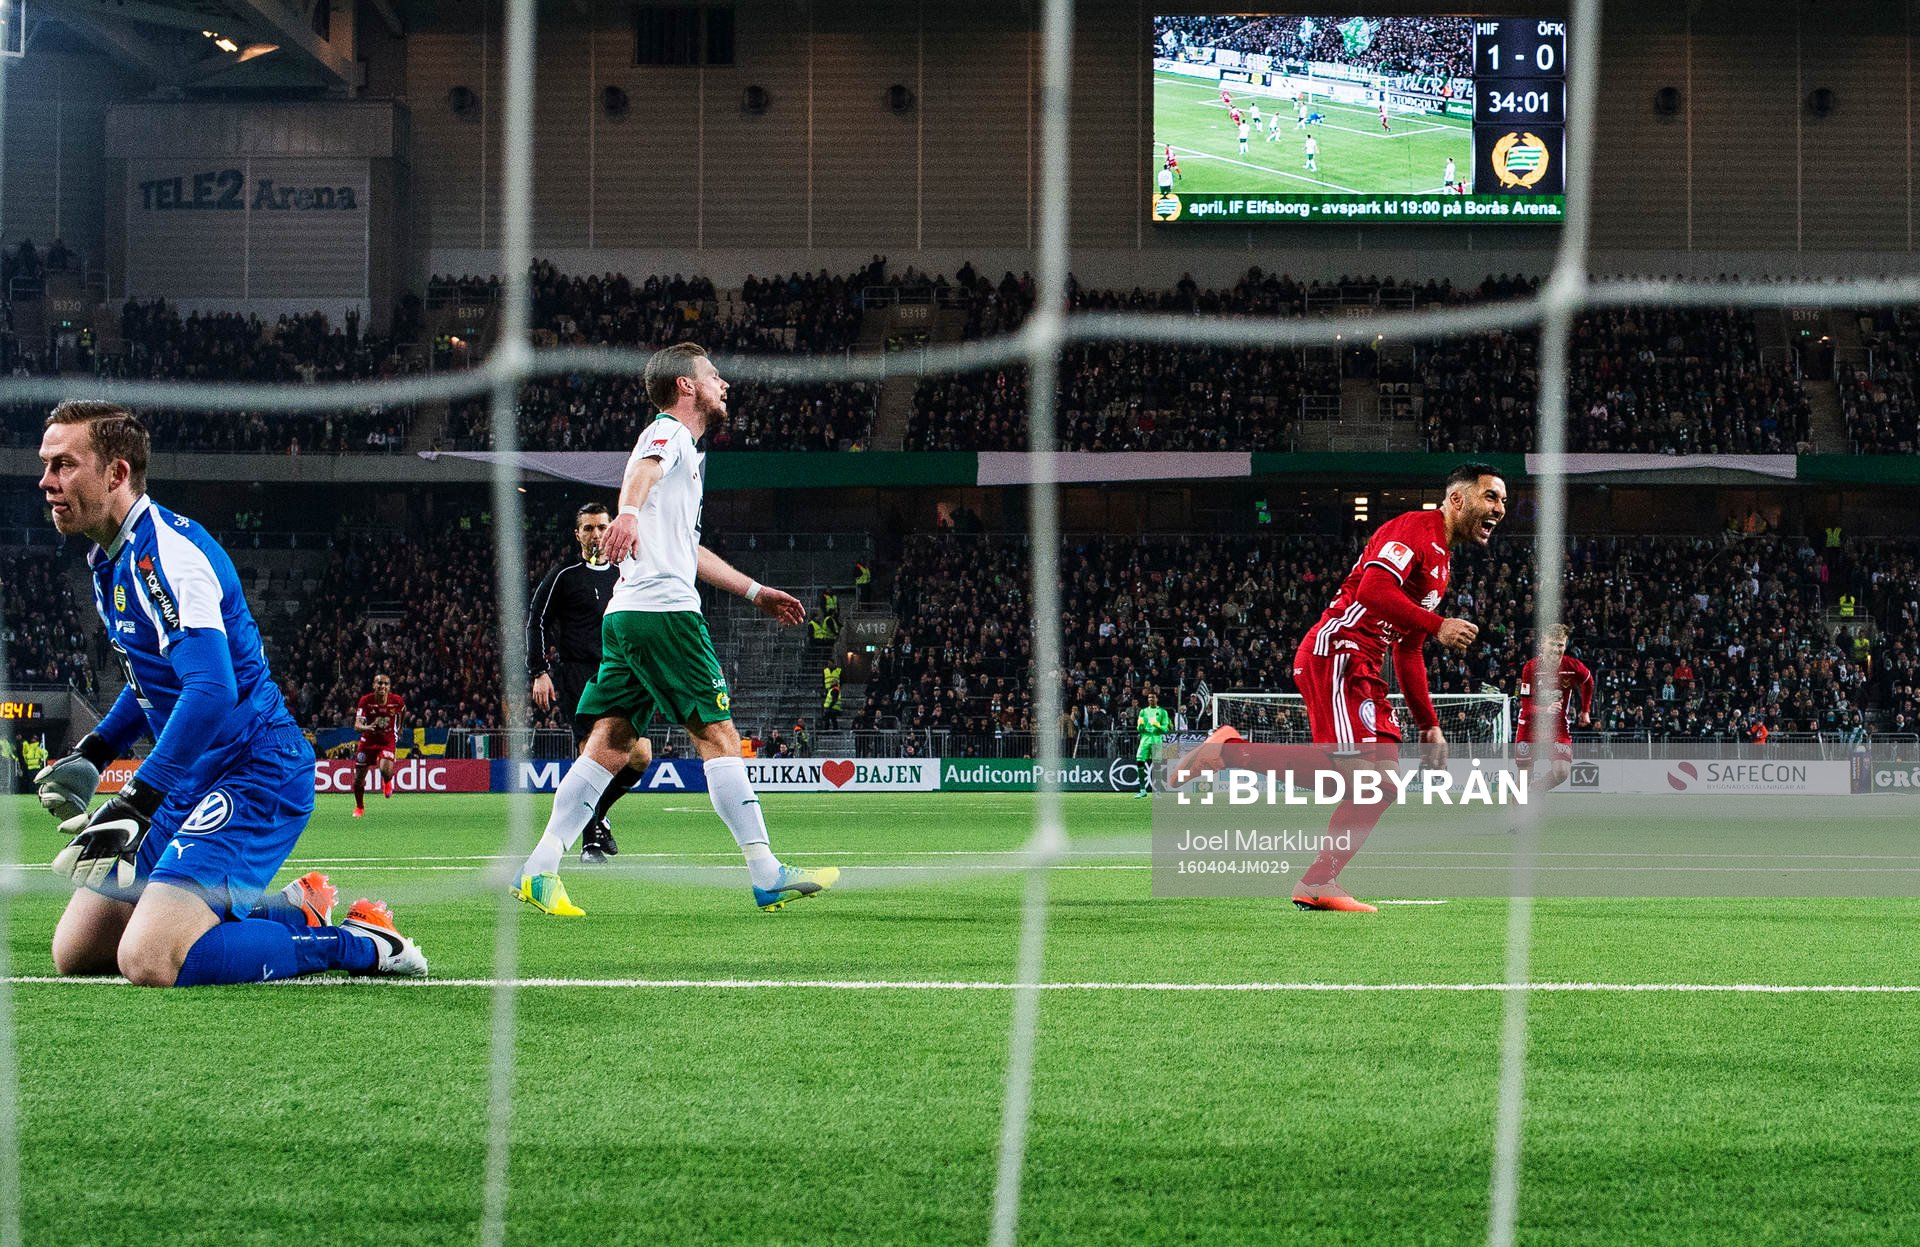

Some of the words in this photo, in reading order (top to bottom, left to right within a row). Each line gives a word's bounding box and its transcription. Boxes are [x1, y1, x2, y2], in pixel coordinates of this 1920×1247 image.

[1476, 22, 1499, 35] HIF
[1537, 20, 1564, 36] ÖFK
[1488, 44, 1499, 70] 1
[1536, 44, 1554, 70] 0
[1488, 91, 1549, 113] 34:01
[140, 168, 245, 210] TELE2
[252, 179, 357, 210] Arena
[1189, 200, 1227, 217] april,
[1229, 200, 1244, 214] IF
[1246, 200, 1310, 217] Elfsborg
[1322, 200, 1382, 217] avspark
[1384, 200, 1398, 214] kl
[1401, 201, 1440, 214] 19:00
[1443, 200, 1462, 217] på
[1465, 200, 1510, 214] Borås
[1512, 201, 1562, 214] Arena.
[458, 307, 485, 318] B319
[900, 308, 928, 319] B318
[146, 571, 180, 629] YOKOHAMA
[855, 622, 886, 634] A118
[855, 765, 922, 784] BAJEN
